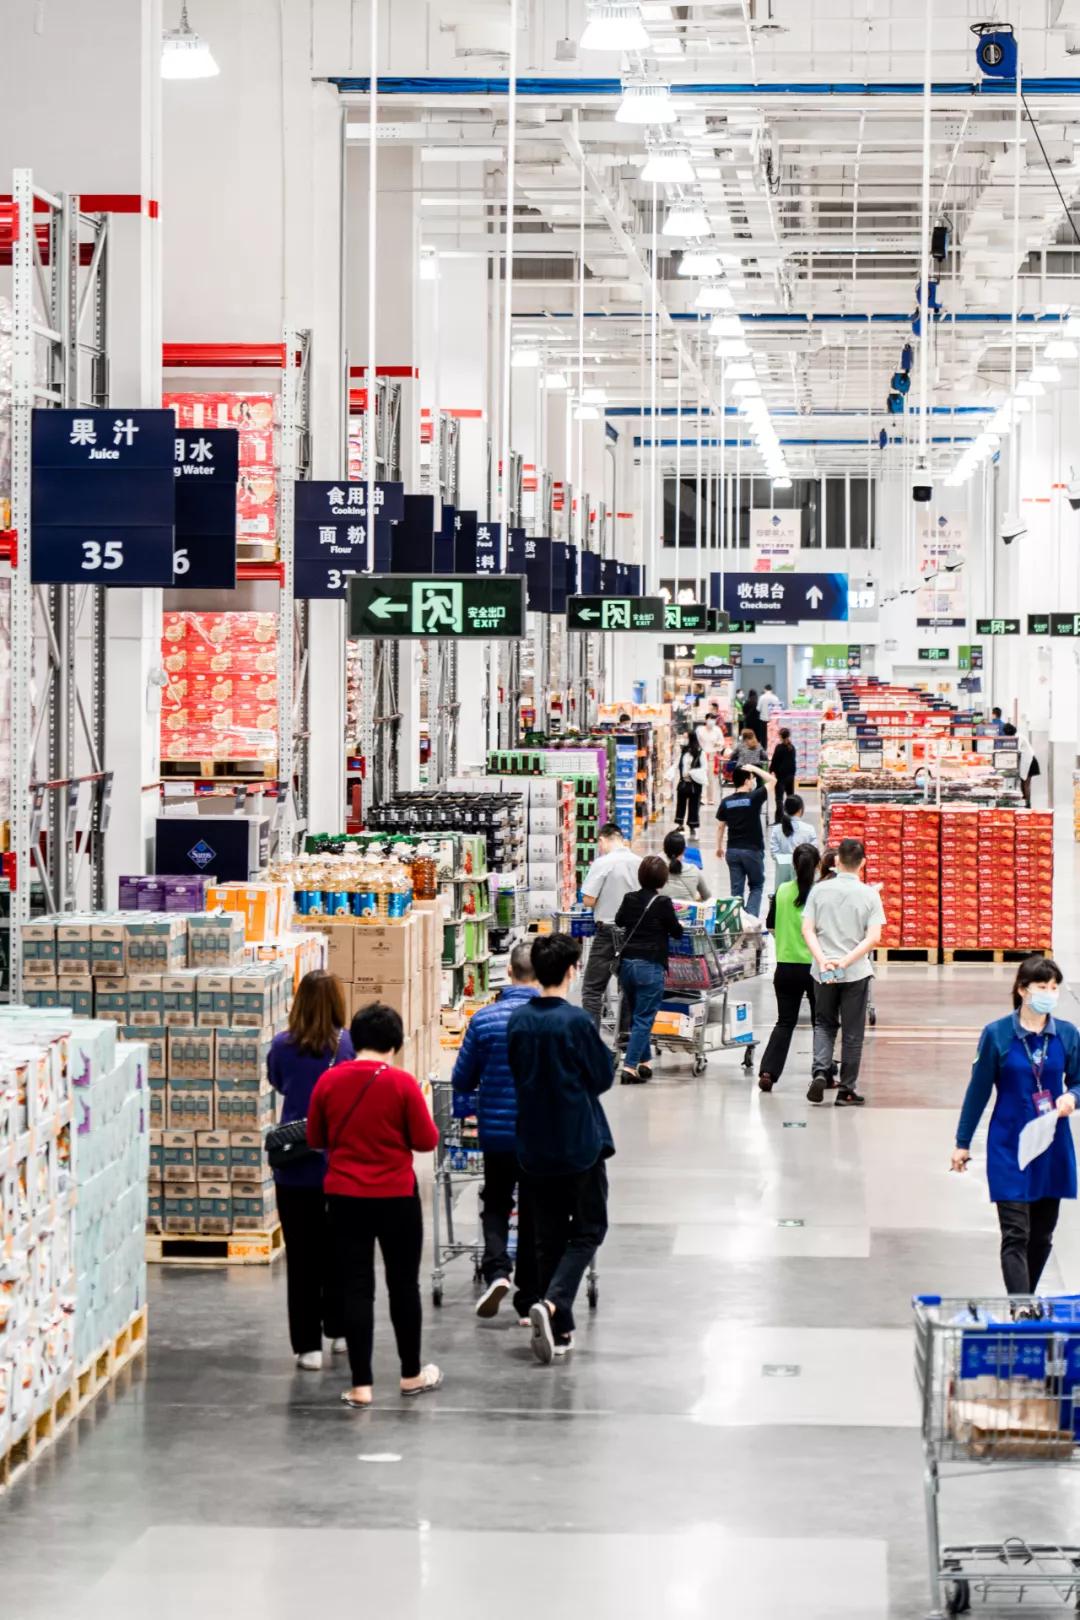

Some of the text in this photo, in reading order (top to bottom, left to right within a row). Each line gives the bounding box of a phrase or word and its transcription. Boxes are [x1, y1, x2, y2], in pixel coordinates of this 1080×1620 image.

[70, 419, 139, 446] 果汁
[88, 448, 120, 460] Juice
[183, 465, 215, 475] Water
[332, 507, 366, 516] Cooking
[319, 525, 366, 545] 面粉
[81, 541, 124, 570] 35
[330, 545, 353, 554] Flour
[737, 582, 785, 599] 收银台
[740, 601, 781, 610] Checkouts
[467, 606, 506, 619] 安全出口
[473, 619, 499, 629] EXIT
